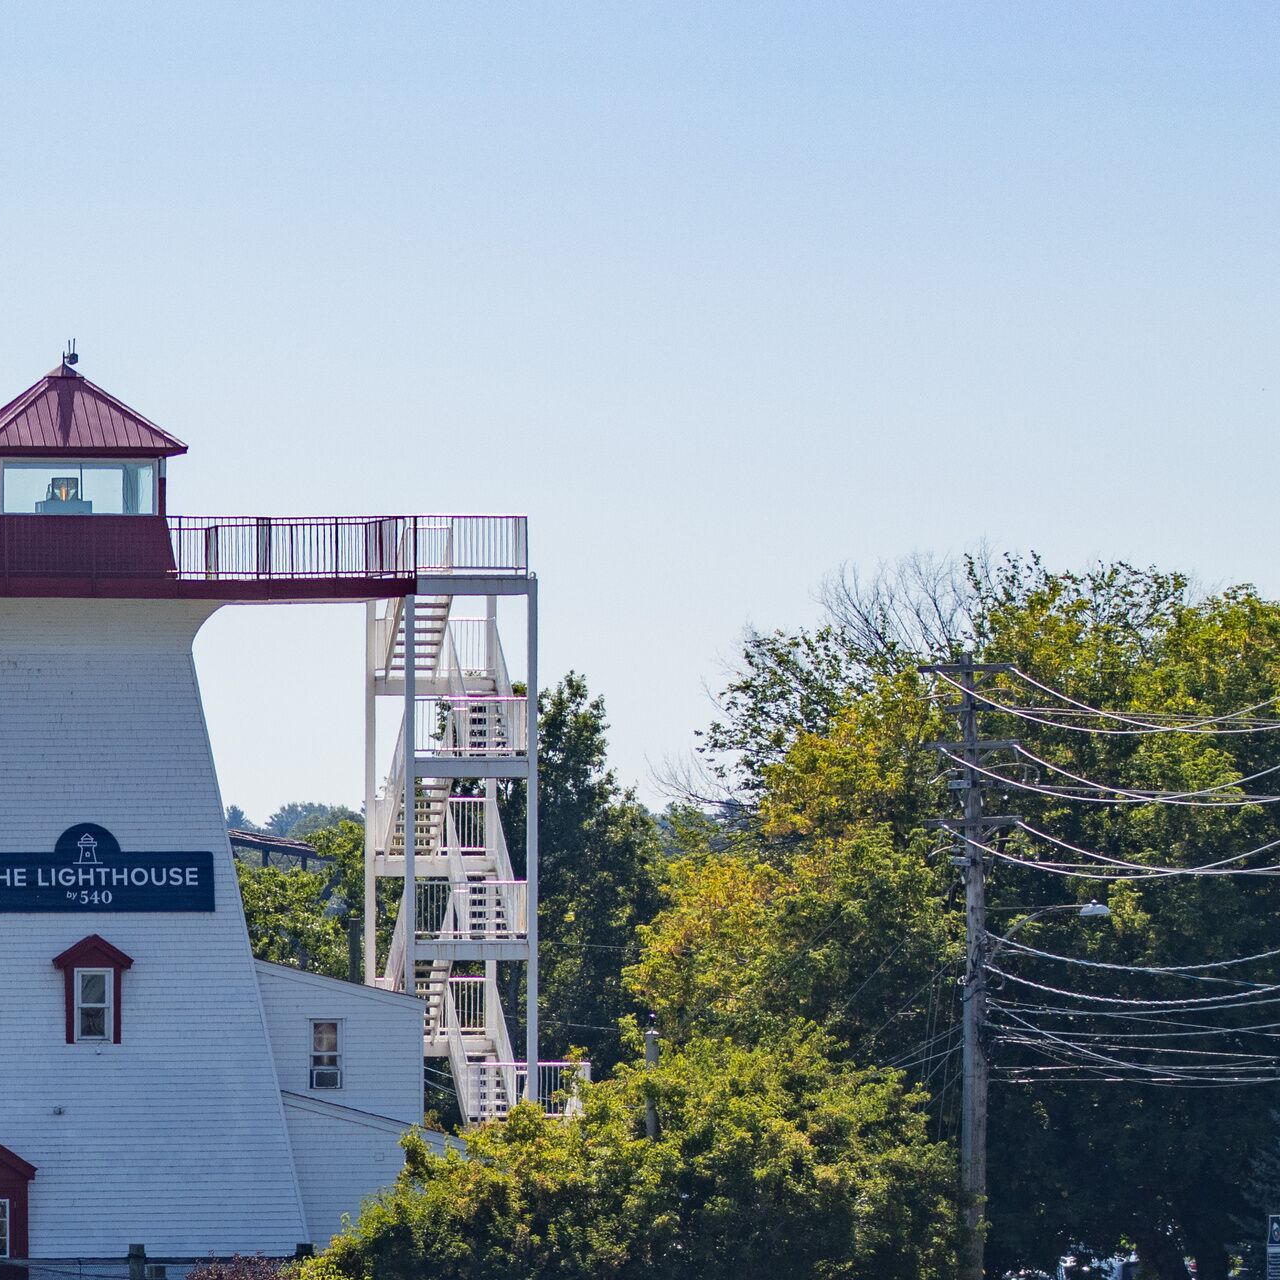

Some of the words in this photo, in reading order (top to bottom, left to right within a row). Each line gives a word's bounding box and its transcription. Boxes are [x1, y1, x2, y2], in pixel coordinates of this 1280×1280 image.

[37, 867, 199, 887] LIGHTHOUSE
[66, 890, 78, 901] by
[79, 890, 113, 905] 540
